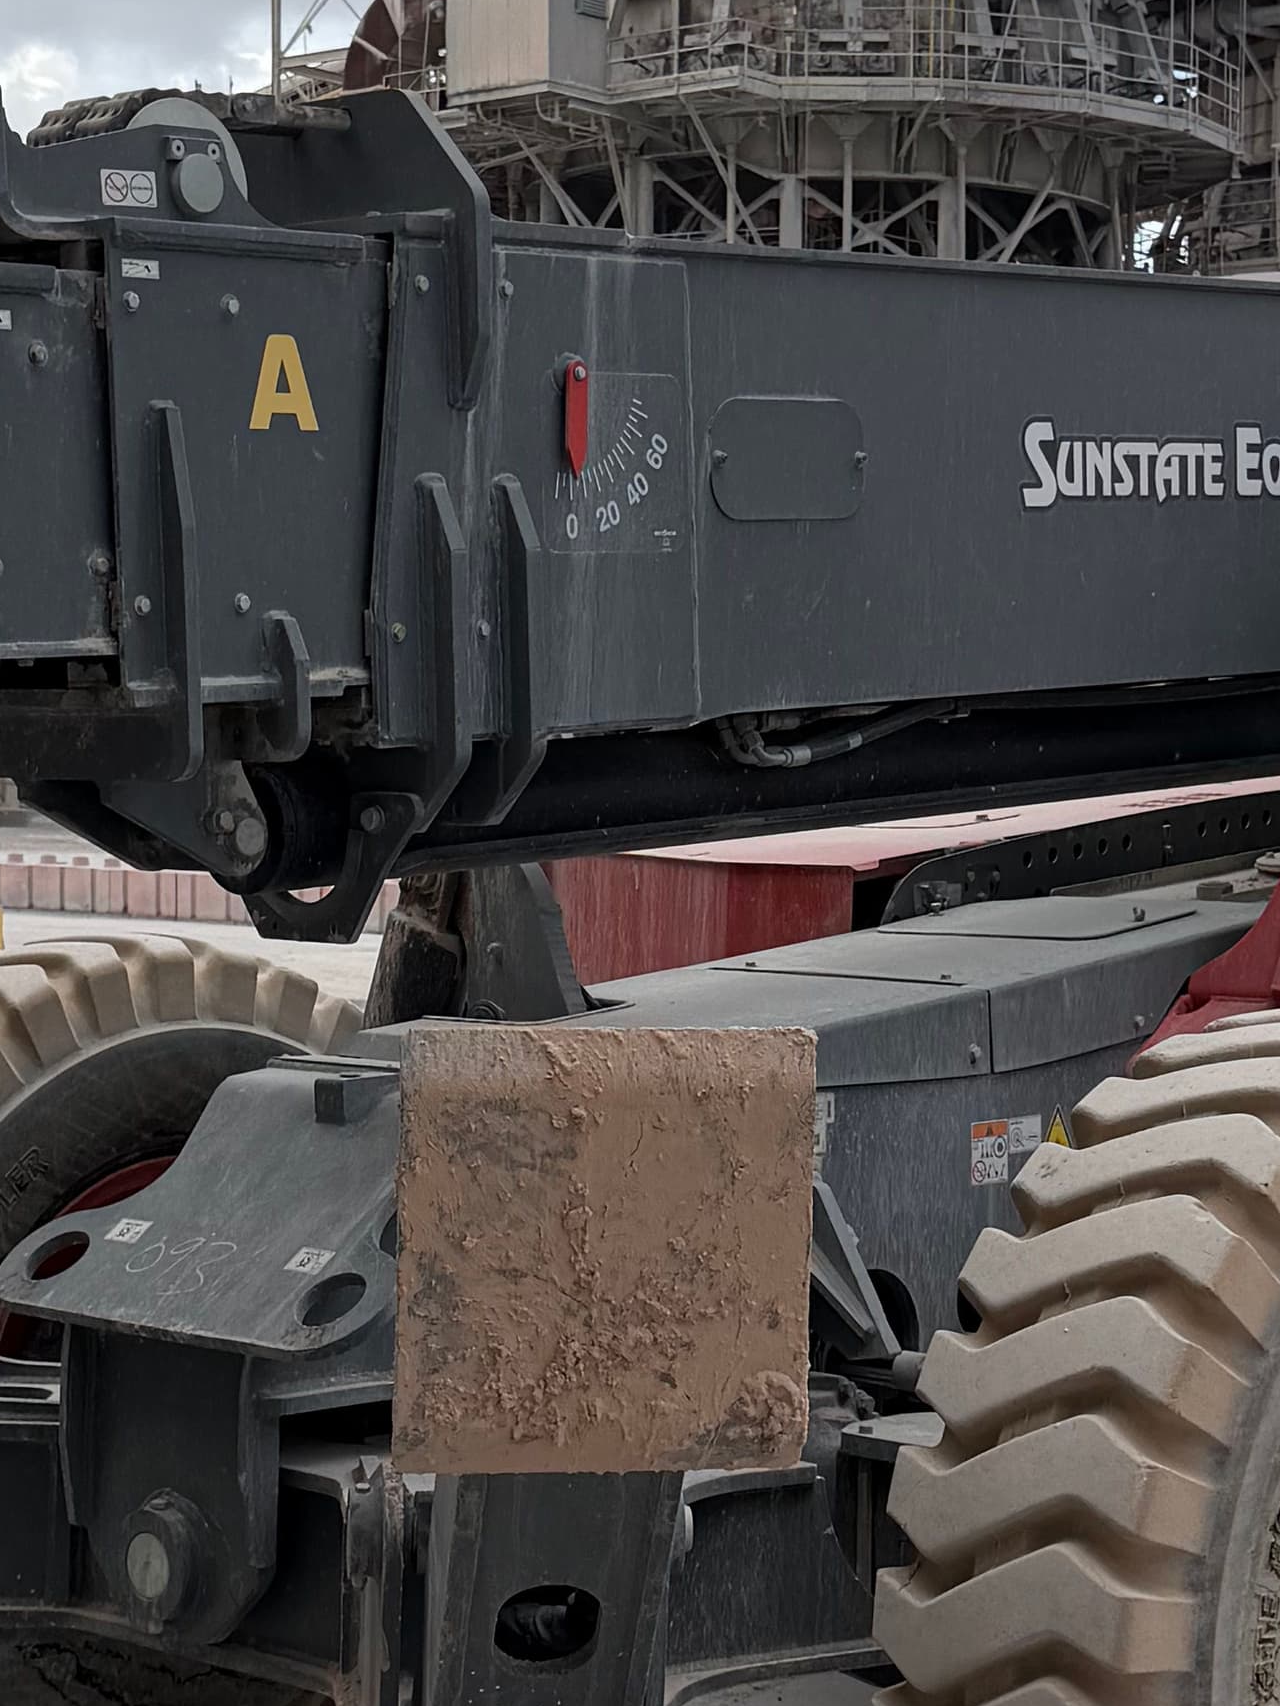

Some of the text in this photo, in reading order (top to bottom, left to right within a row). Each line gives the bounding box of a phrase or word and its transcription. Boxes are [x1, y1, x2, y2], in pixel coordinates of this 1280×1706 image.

[249, 334, 319, 431] A
[566, 433, 668, 539] 0 20 40 60
